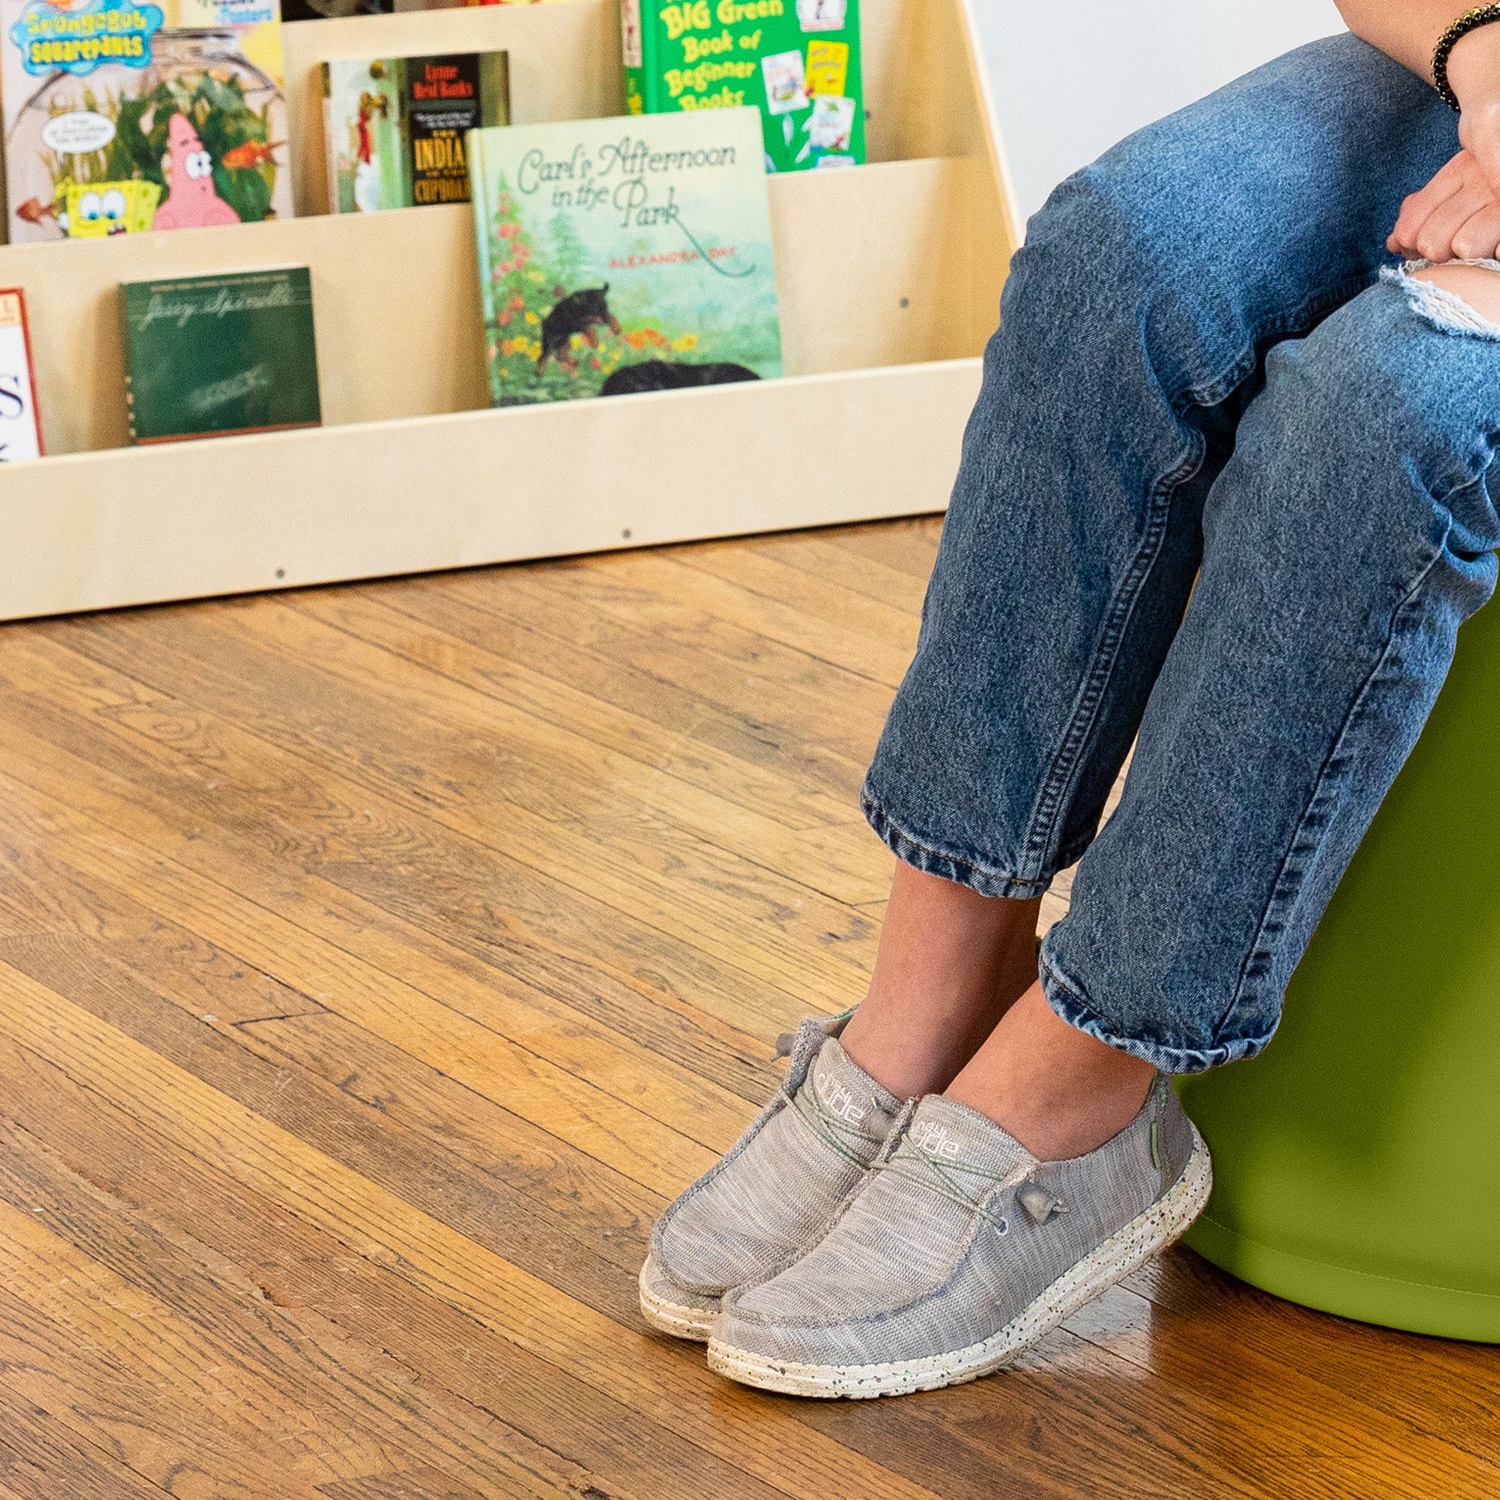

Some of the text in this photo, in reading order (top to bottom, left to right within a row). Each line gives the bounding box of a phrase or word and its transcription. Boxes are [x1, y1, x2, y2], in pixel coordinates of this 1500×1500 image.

[680, 28, 763, 64] Book of
[663, 61, 757, 98] Beginner
[677, 85, 746, 112] Books
[414, 137, 466, 171] INDIA
[517, 136, 737, 195] Carl's Afternoon
[551, 177, 680, 229] in the Park
[609, 249, 701, 270] ALEXANDRA
[915, 1128, 960, 1161] de
